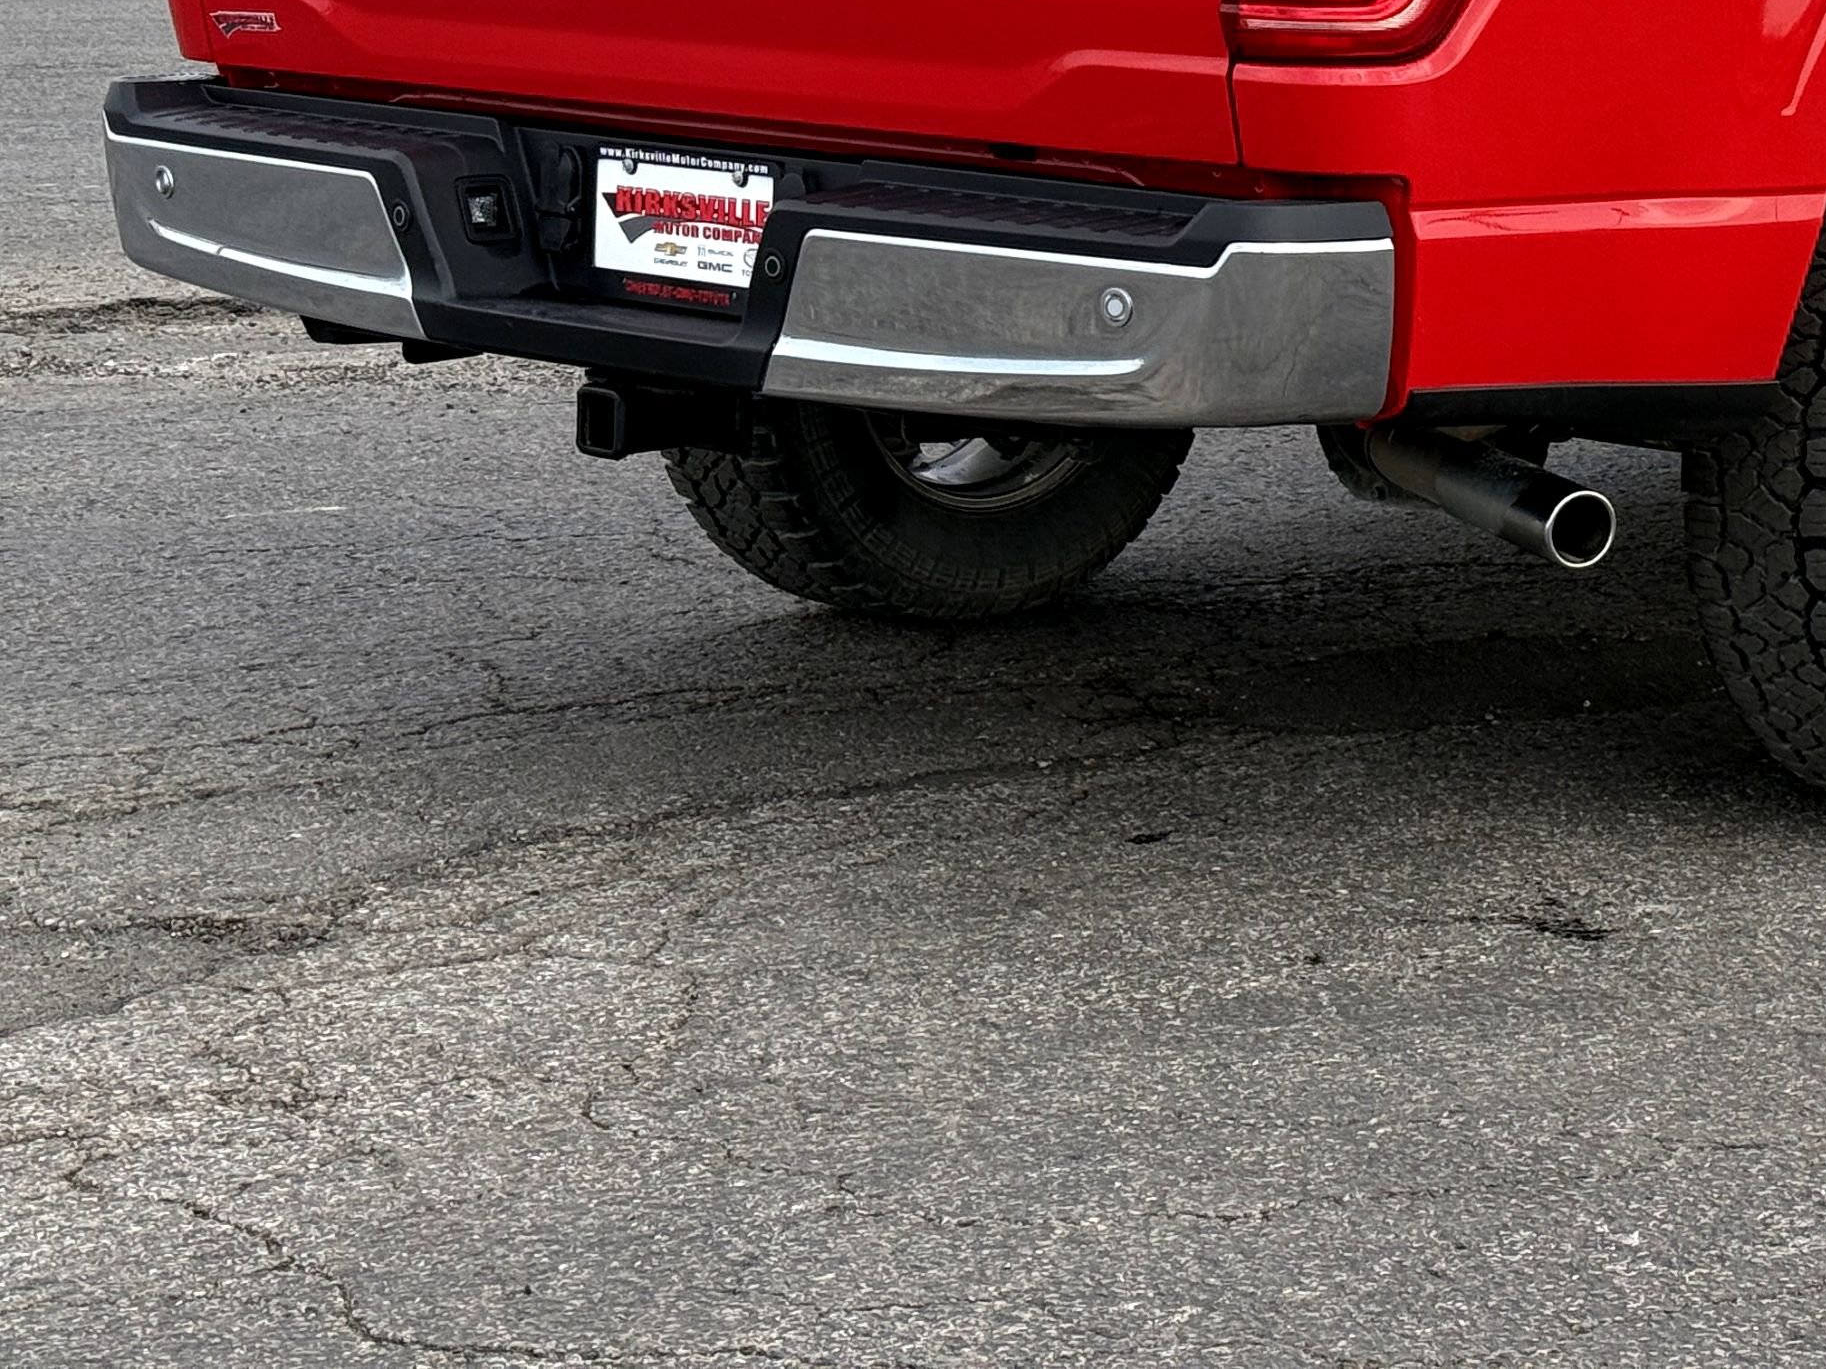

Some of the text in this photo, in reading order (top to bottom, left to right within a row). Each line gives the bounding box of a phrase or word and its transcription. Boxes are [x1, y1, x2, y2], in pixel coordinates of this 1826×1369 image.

[600, 146, 768, 174] www.KirksvilleMotorCompany.com
[615, 185, 770, 228] KIRKSVILLE
[652, 221, 763, 245] MOTOR COMPAN
[697, 260, 733, 273] GMC
